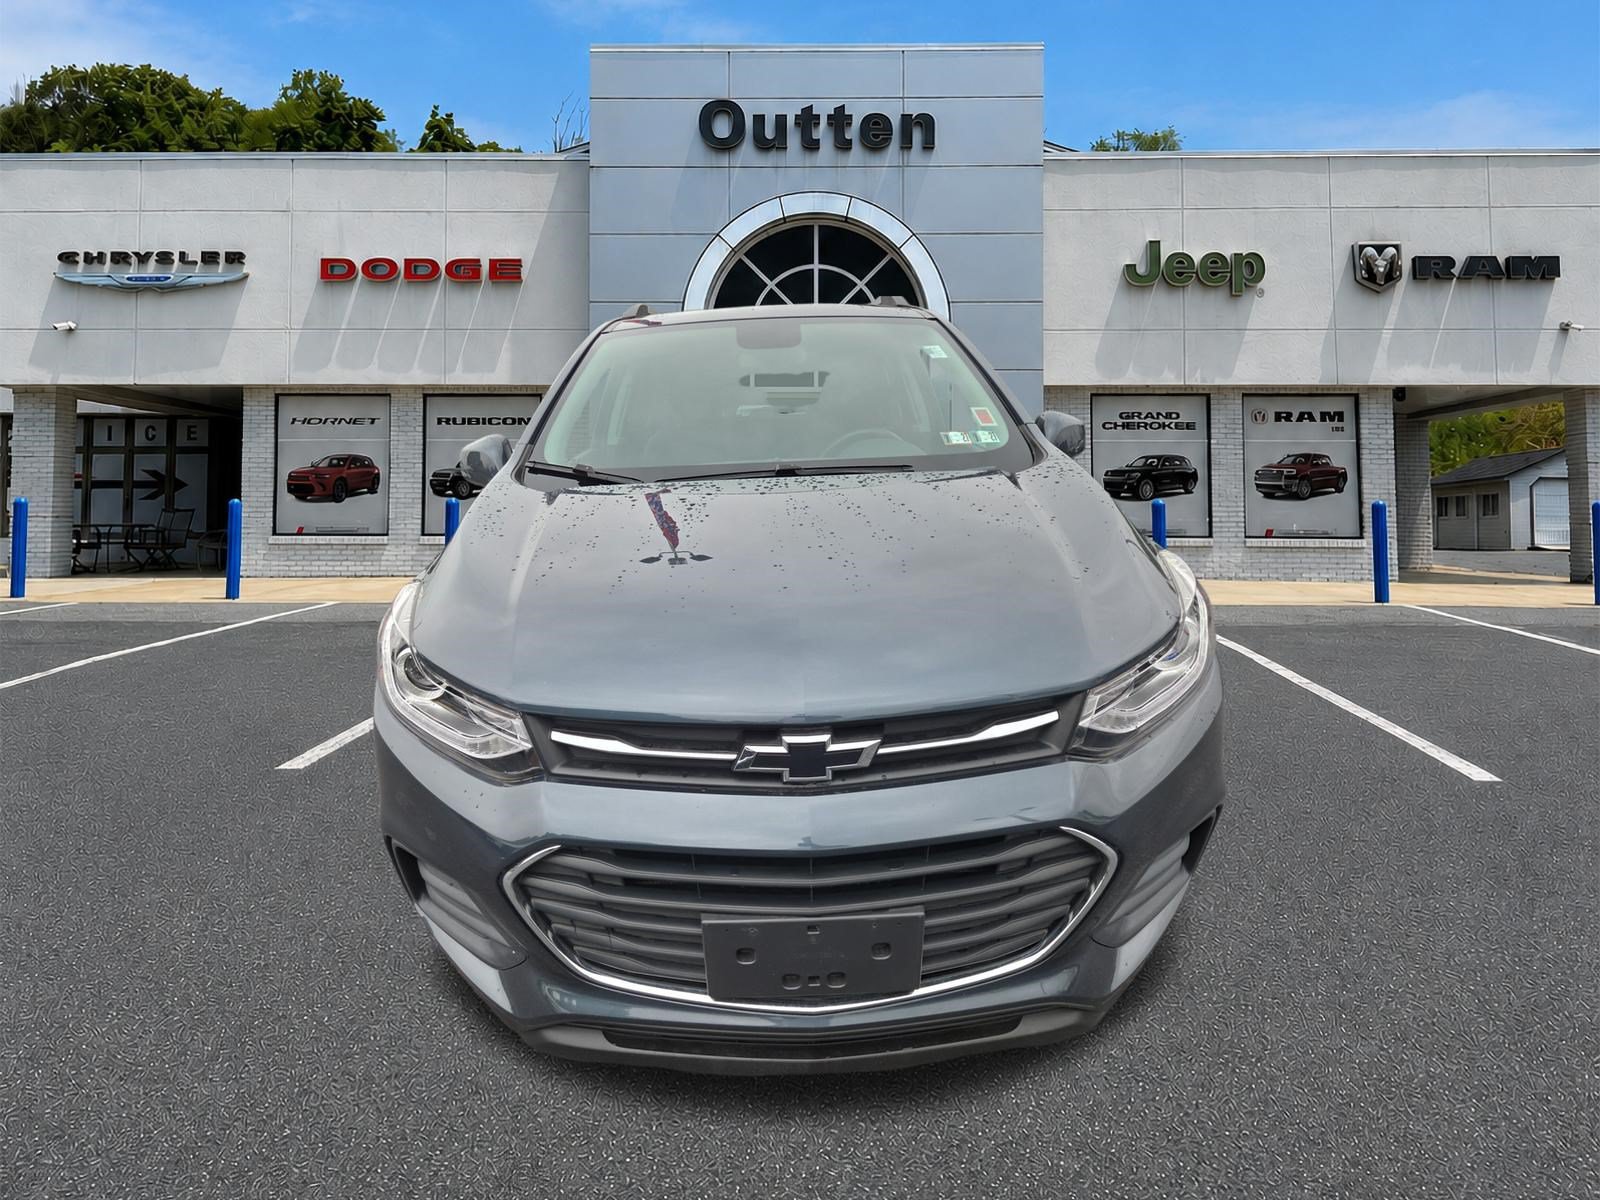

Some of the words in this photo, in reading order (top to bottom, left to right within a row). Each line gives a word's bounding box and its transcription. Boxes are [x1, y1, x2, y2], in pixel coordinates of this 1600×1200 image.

[699, 99, 937, 150] Outten
[56, 250, 247, 266] CHRYSLER
[320, 257, 523, 282] DODGE
[1123, 240, 1266, 296] Jeep
[1411, 255, 1561, 280] RAM
[290, 417, 382, 426] HORNET
[1118, 411, 1181, 421] GRAND
[1273, 411, 1345, 423] RAM
[1101, 421, 1197, 431] CHEROKEE
